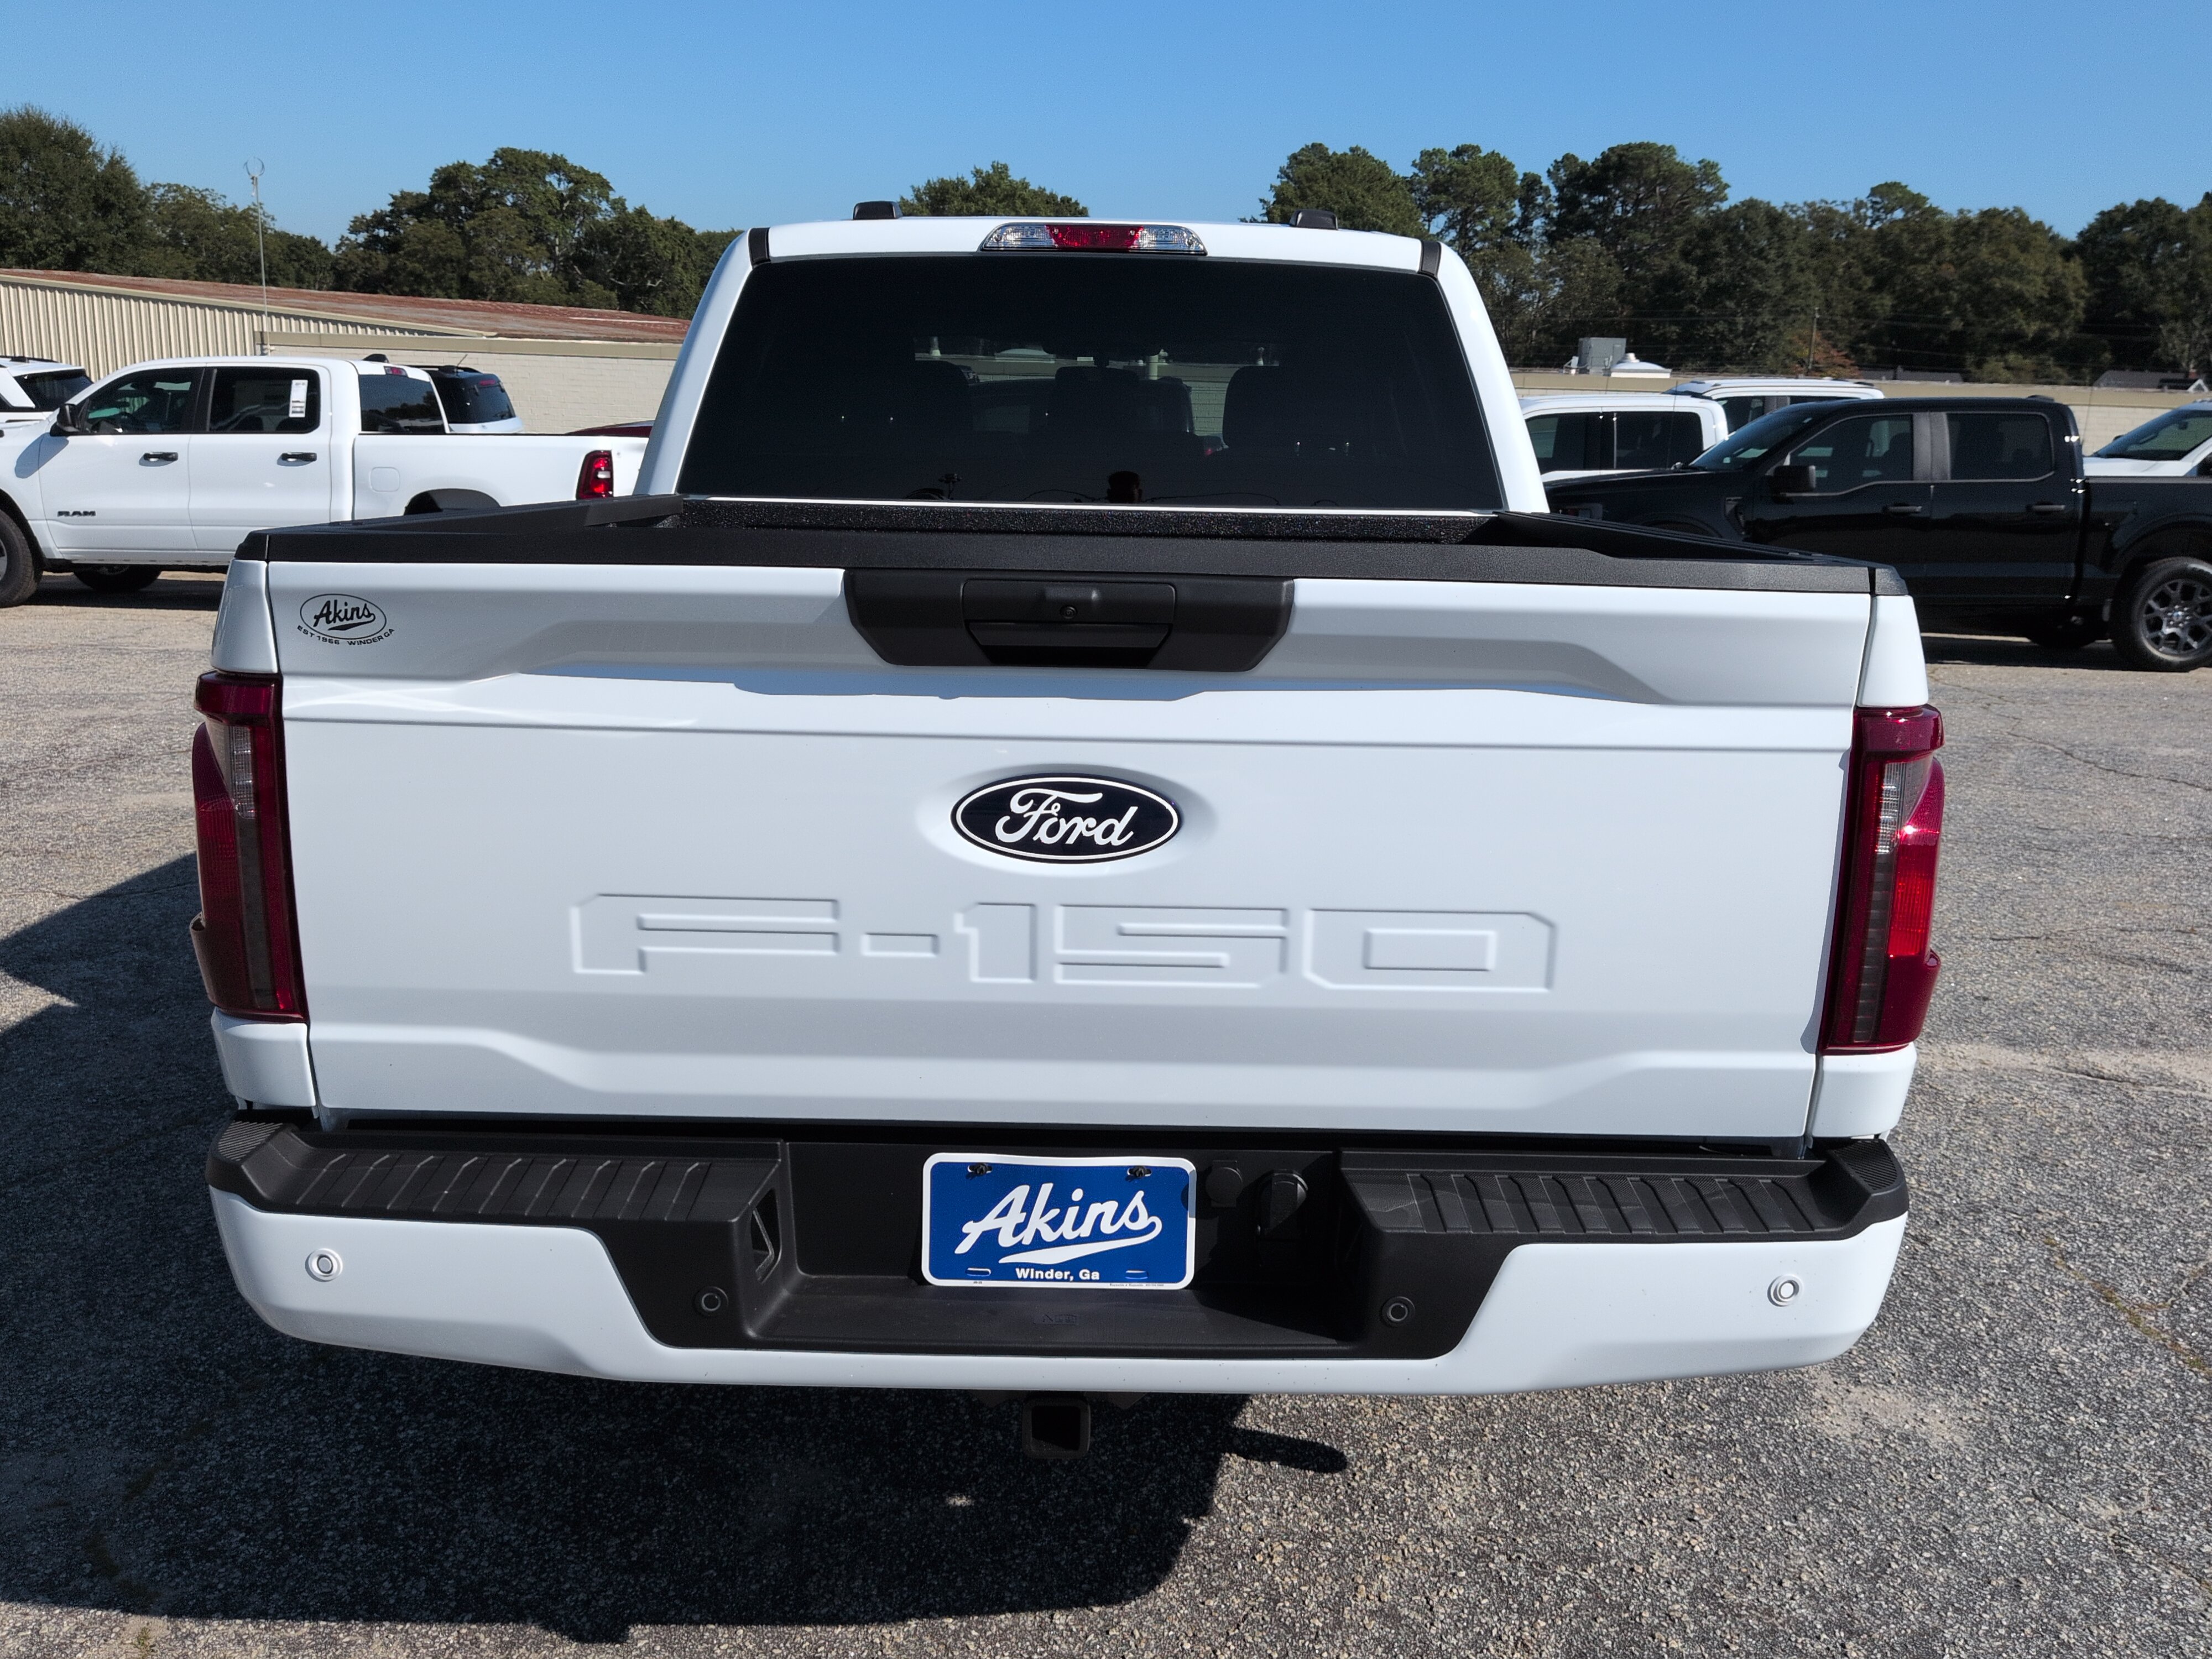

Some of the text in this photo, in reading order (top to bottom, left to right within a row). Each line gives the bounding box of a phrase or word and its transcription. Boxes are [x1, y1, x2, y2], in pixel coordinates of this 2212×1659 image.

[297, 624, 314, 638] EST
[347, 636, 384, 645] WINDER
[384, 628, 395, 638] GA
[313, 599, 376, 631] Akins
[995, 787, 1138, 846] Ford
[570, 893, 1558, 993] F-150
[954, 1182, 1162, 1264] Akins
[1015, 1267, 1100, 1282] Winder, Ga
